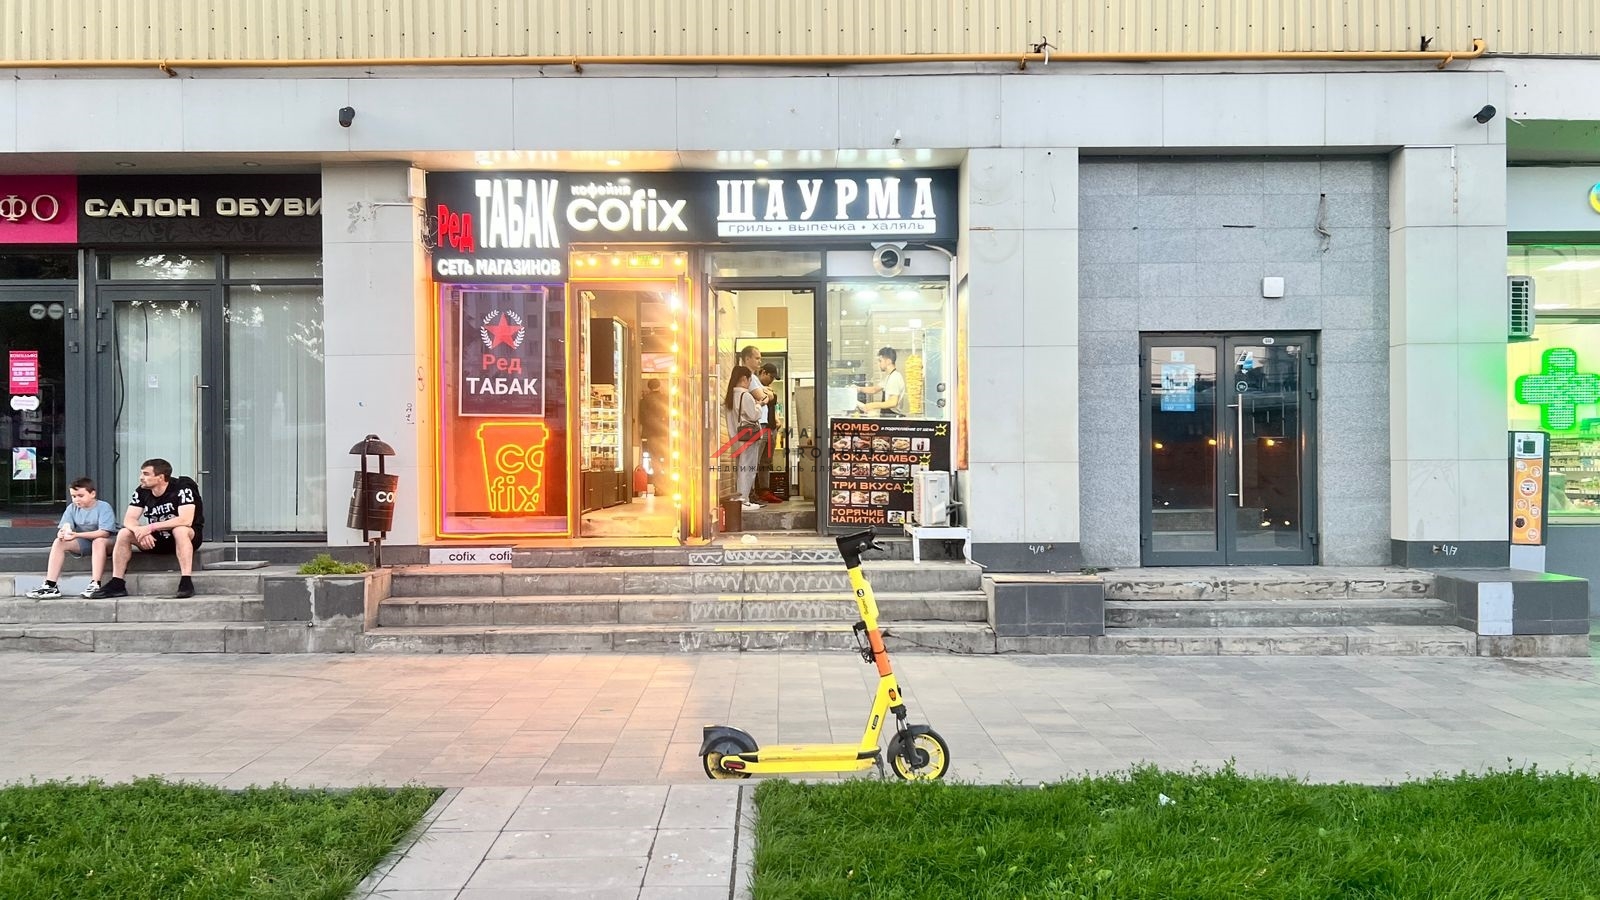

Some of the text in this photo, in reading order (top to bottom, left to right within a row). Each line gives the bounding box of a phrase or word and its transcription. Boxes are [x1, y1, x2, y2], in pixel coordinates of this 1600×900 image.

[571, 181, 631, 199] кофейня
[84, 197, 322, 217] САЛОН ОБУВИ
[716, 177, 937, 221] ШАУРМА
[437, 179, 560, 253] Ред ТАБАК
[566, 188, 688, 232] cofix
[728, 220, 925, 234] гриль выпечка халяль
[437, 257, 561, 276] СЕТЬ МАГАЗИНОВ
[482, 354, 522, 374] Ред
[466, 376, 538, 396] ТАБАК
[833, 423, 879, 432] КОМБО
[832, 453, 918, 464] КОКА-КОМБО
[832, 481, 901, 491] ТРИ ВКУСА
[178, 488, 195, 503] 13
[831, 509, 884, 517] ГОРЯЧИЕ
[831, 516, 884, 524] НАПИТКИ
[449, 551, 476, 561] cofix
